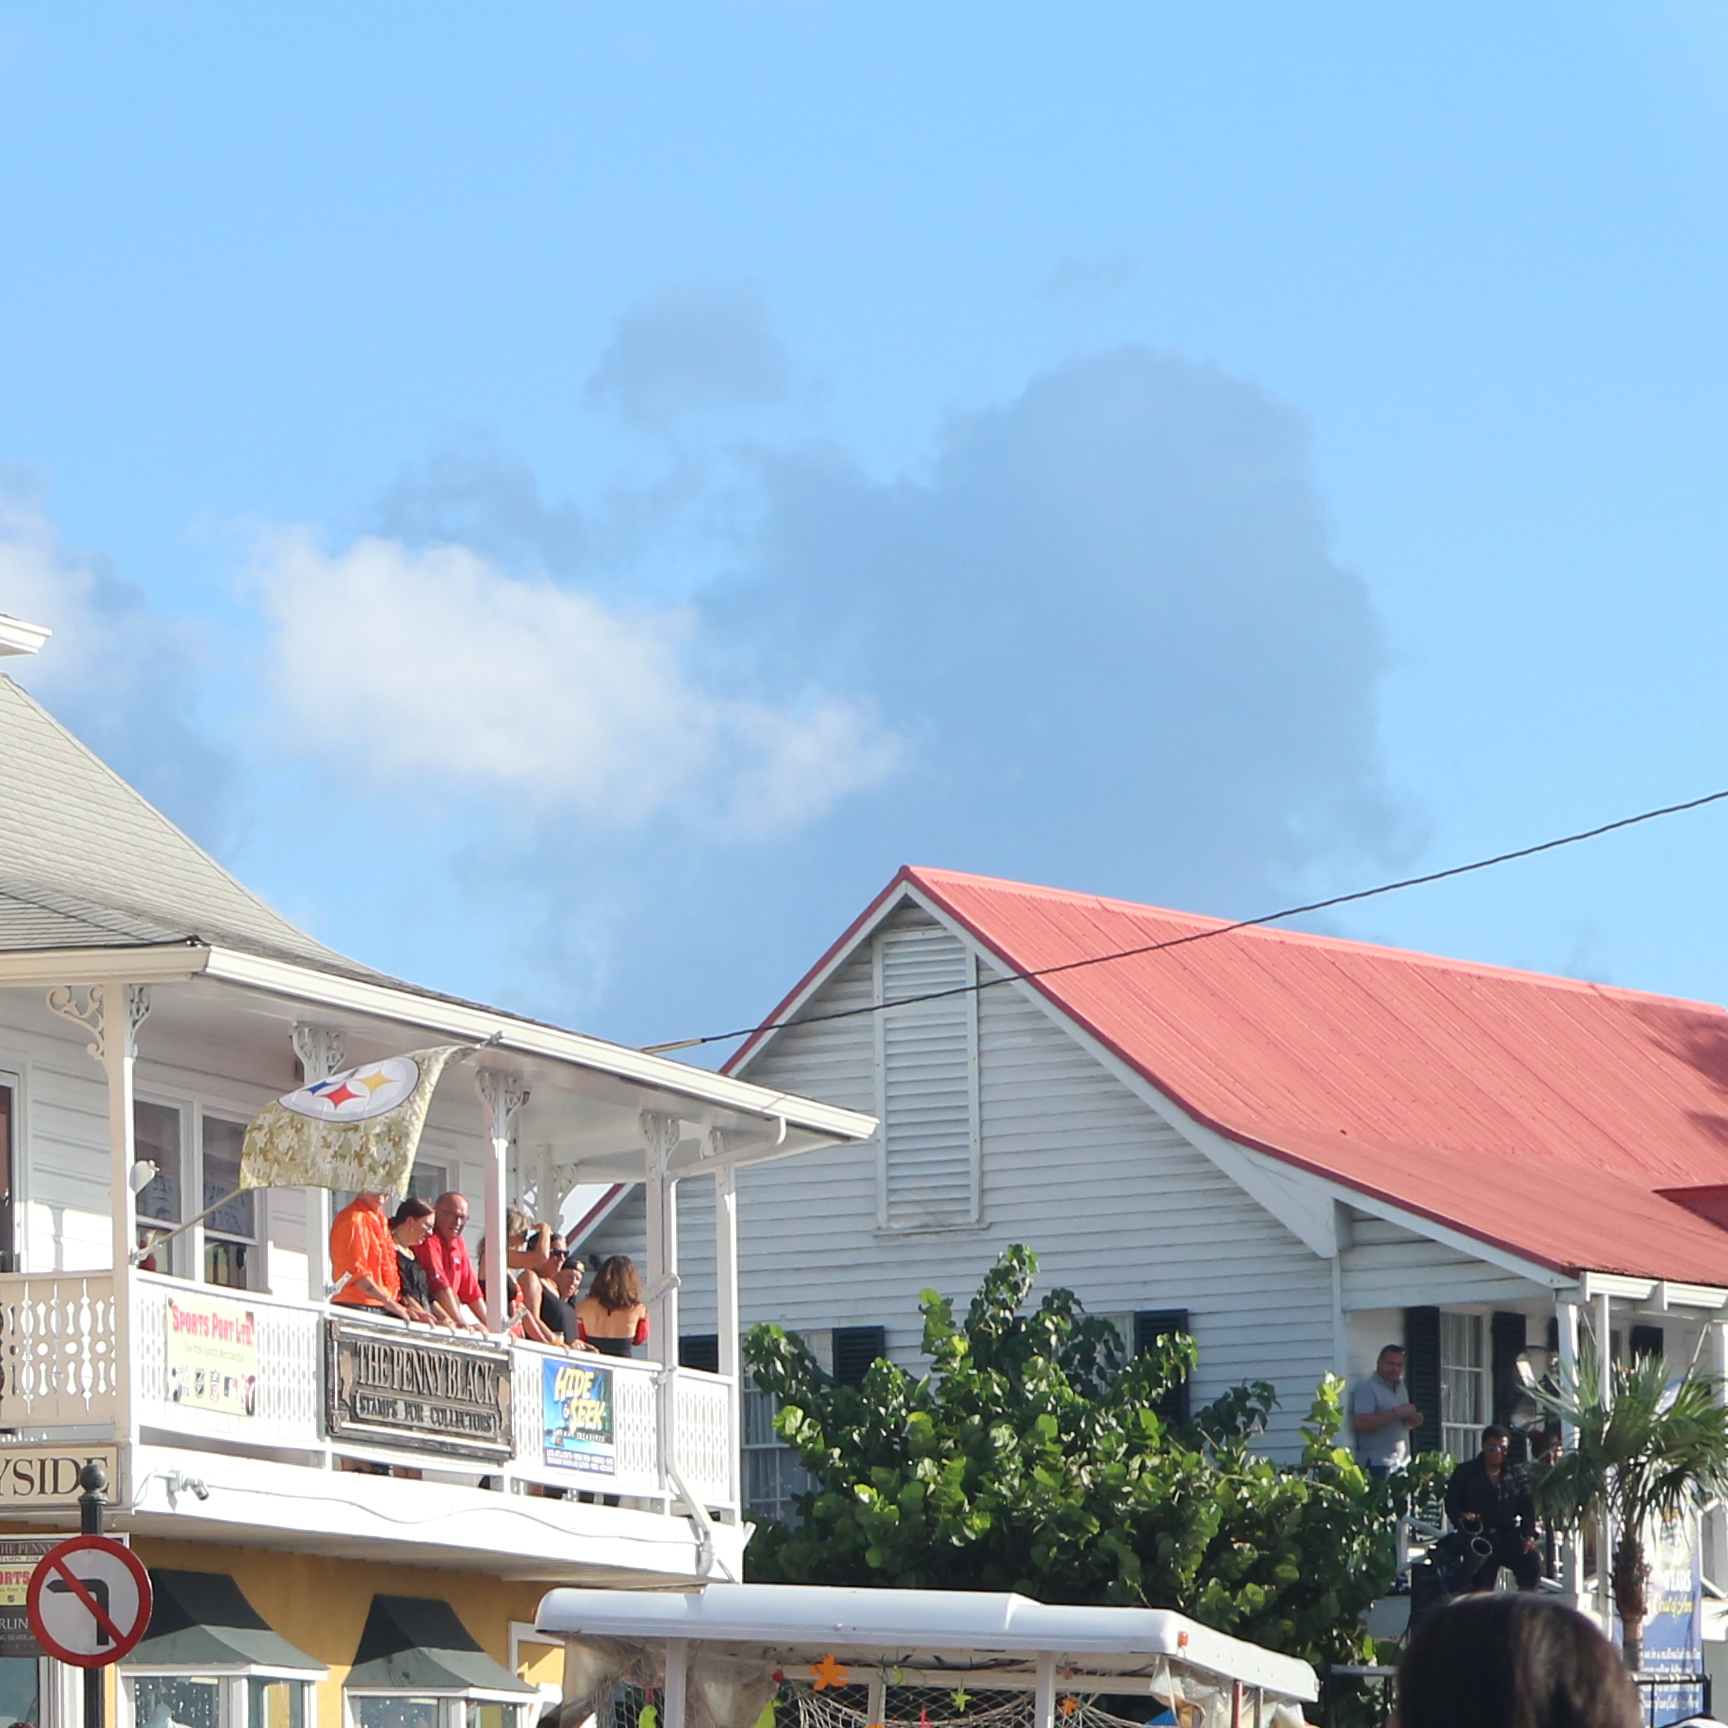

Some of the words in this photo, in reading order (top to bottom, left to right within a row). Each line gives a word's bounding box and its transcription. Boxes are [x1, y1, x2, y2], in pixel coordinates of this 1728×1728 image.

[172, 1304, 210, 1338] SPORTS
[212, 1312, 234, 1342] PORT
[357, 1342, 391, 1387] THE
[393, 1348, 445, 1396] PENNY
[446, 1353, 496, 1404] BLACK
[554, 1367, 595, 1401] HIDE
[359, 1394, 398, 1419] STAMPS
[404, 1401, 425, 1424] FOR
[430, 1406, 493, 1433] COLLECTORS
[569, 1398, 606, 1436] SEEK
